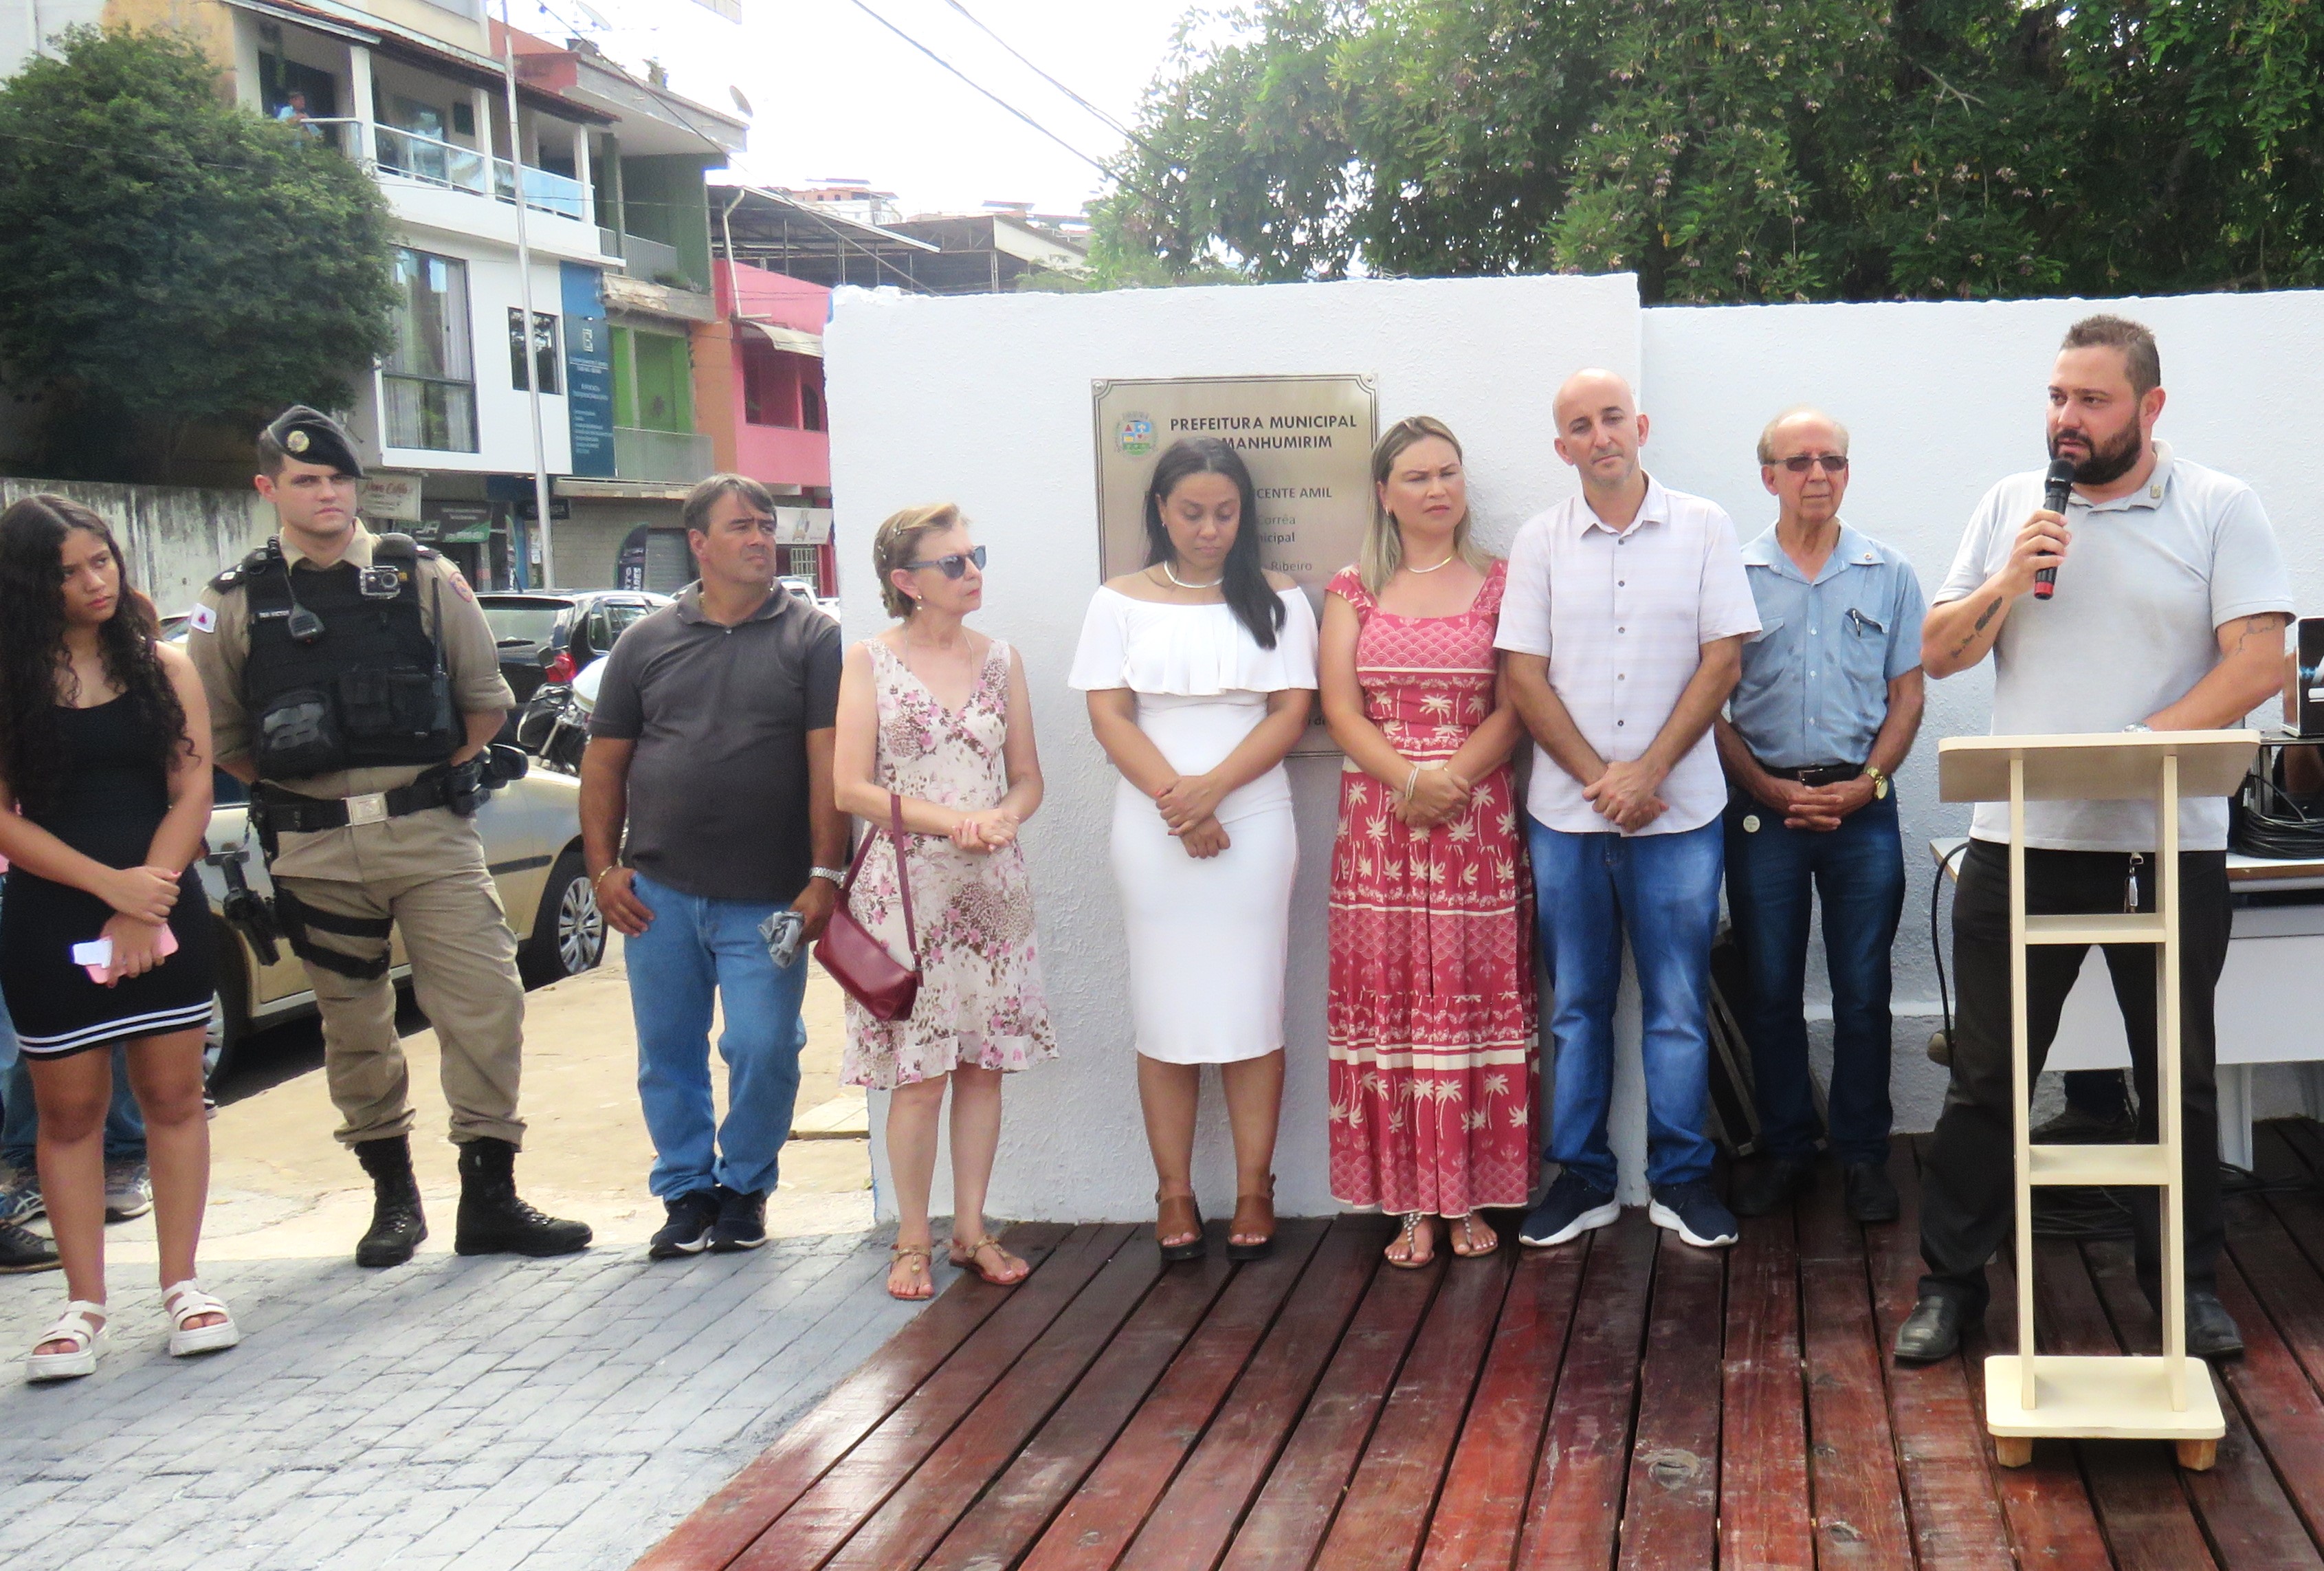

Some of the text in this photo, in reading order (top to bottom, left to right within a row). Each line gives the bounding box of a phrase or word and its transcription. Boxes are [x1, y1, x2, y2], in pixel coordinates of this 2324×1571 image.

[1170, 415, 1357, 431] PREFEITURA MUNICIPAL
[1256, 487, 1332, 498] CENTE AMIL
[1271, 560, 1312, 571] Ribeiro
